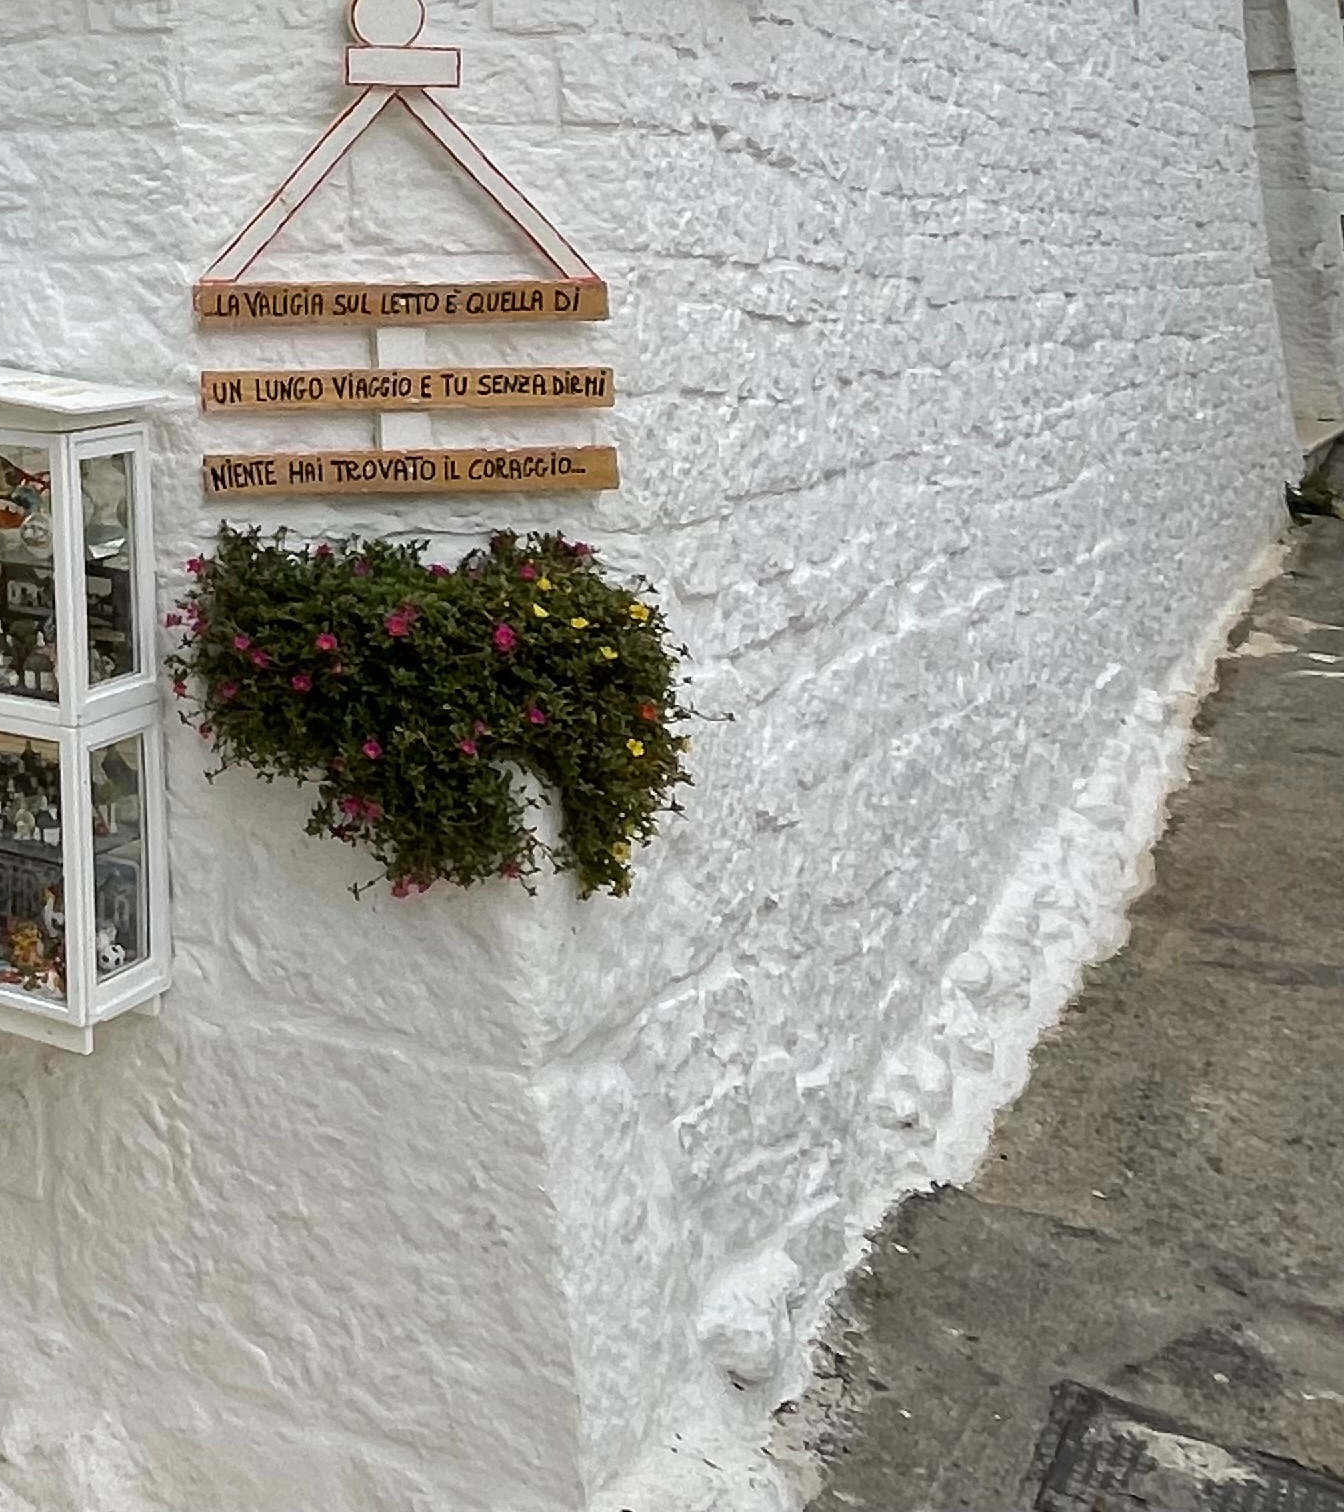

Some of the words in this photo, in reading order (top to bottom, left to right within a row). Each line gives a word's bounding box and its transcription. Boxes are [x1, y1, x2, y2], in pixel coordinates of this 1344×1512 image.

[243, 288, 324, 318] VALIGIA
[332, 293, 372, 316] SUL
[381, 293, 440, 316] LETTO
[466, 289, 544, 315] QUELLA
[554, 287, 581, 313] DI
[212, 378, 242, 404] UN
[256, 376, 324, 402] LUNGO
[332, 372, 412, 400] VIAGGIO
[420, 375, 433, 399] E
[440, 373, 468, 397] TU
[477, 373, 547, 396] SENZA
[552, 370, 607, 398] DIRMI
[211, 459, 278, 492] NIENTE
[289, 457, 324, 485] HAI
[330, 456, 436, 483] TROVATO
[443, 455, 461, 481] IL
